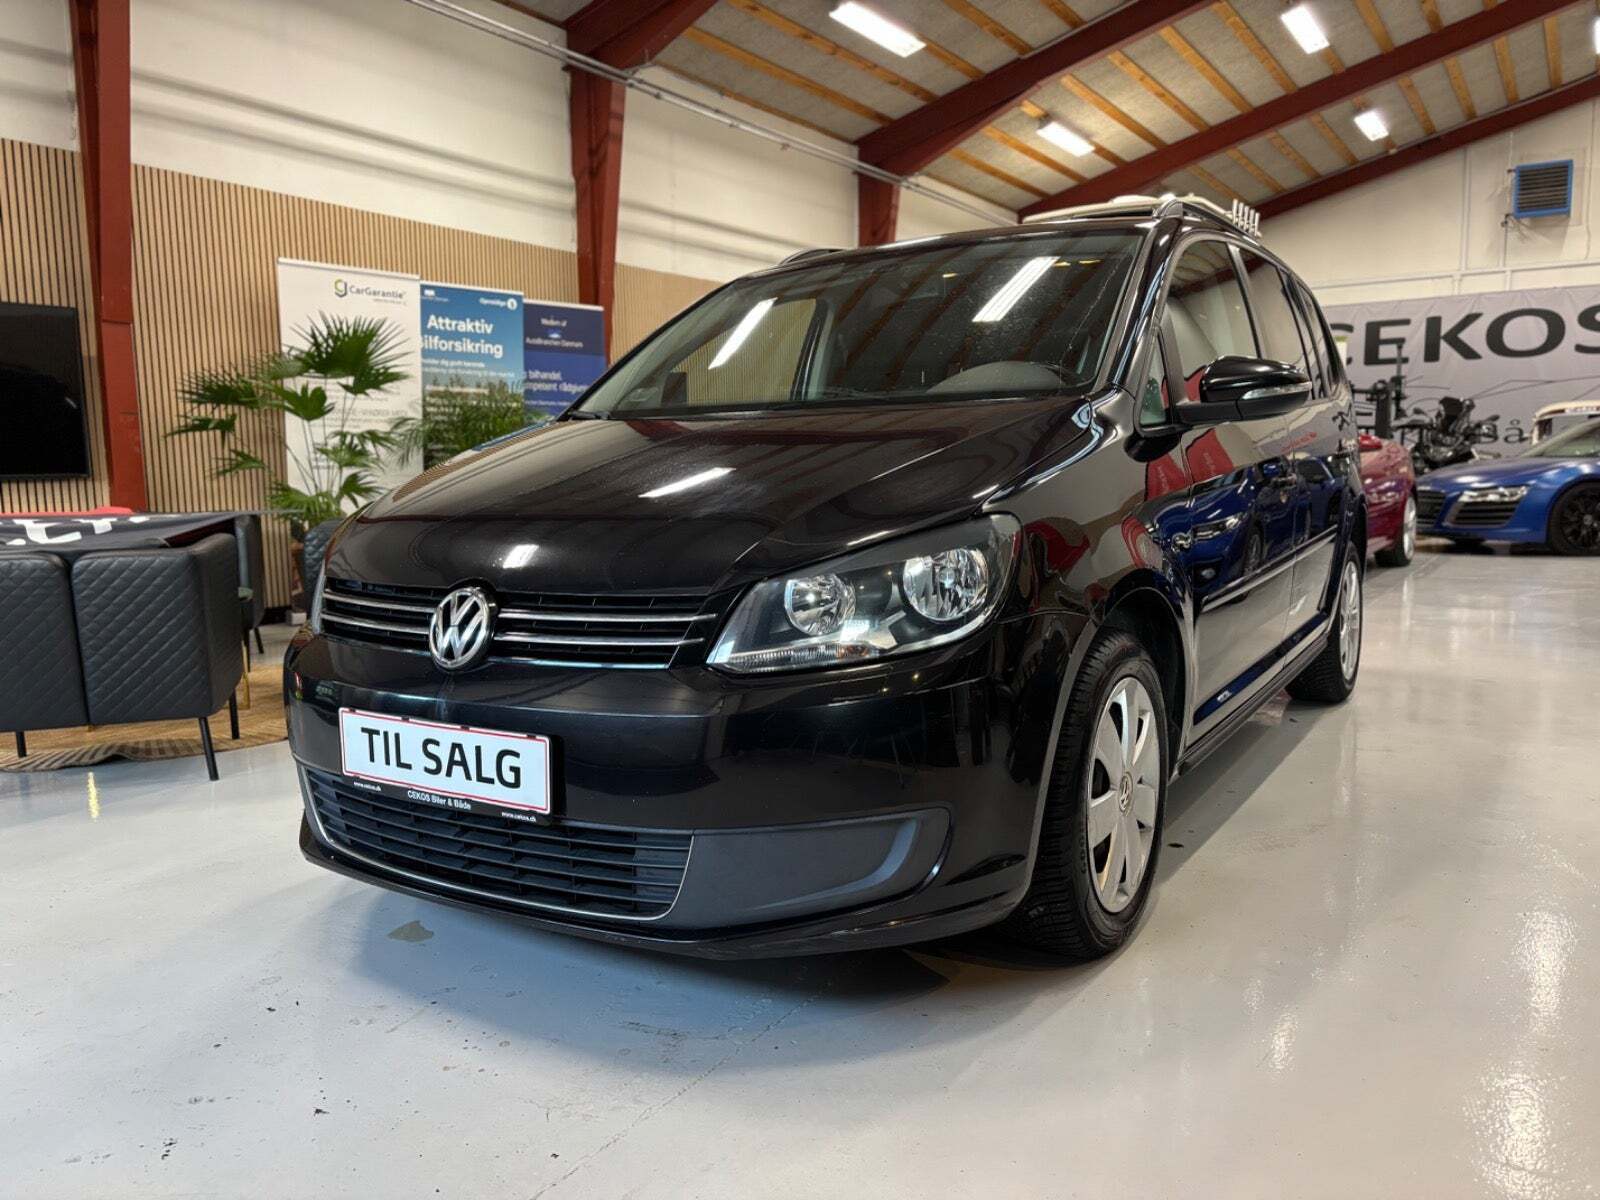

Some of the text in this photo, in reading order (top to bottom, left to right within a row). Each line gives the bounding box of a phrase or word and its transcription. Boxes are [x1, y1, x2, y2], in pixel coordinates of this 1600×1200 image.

[427, 314, 494, 335] Attraktiv
[360, 726, 522, 790] TIL SALG
[407, 790, 431, 802] CEKOS
[431, 794, 446, 806] Biler
[447, 797, 453, 807] &
